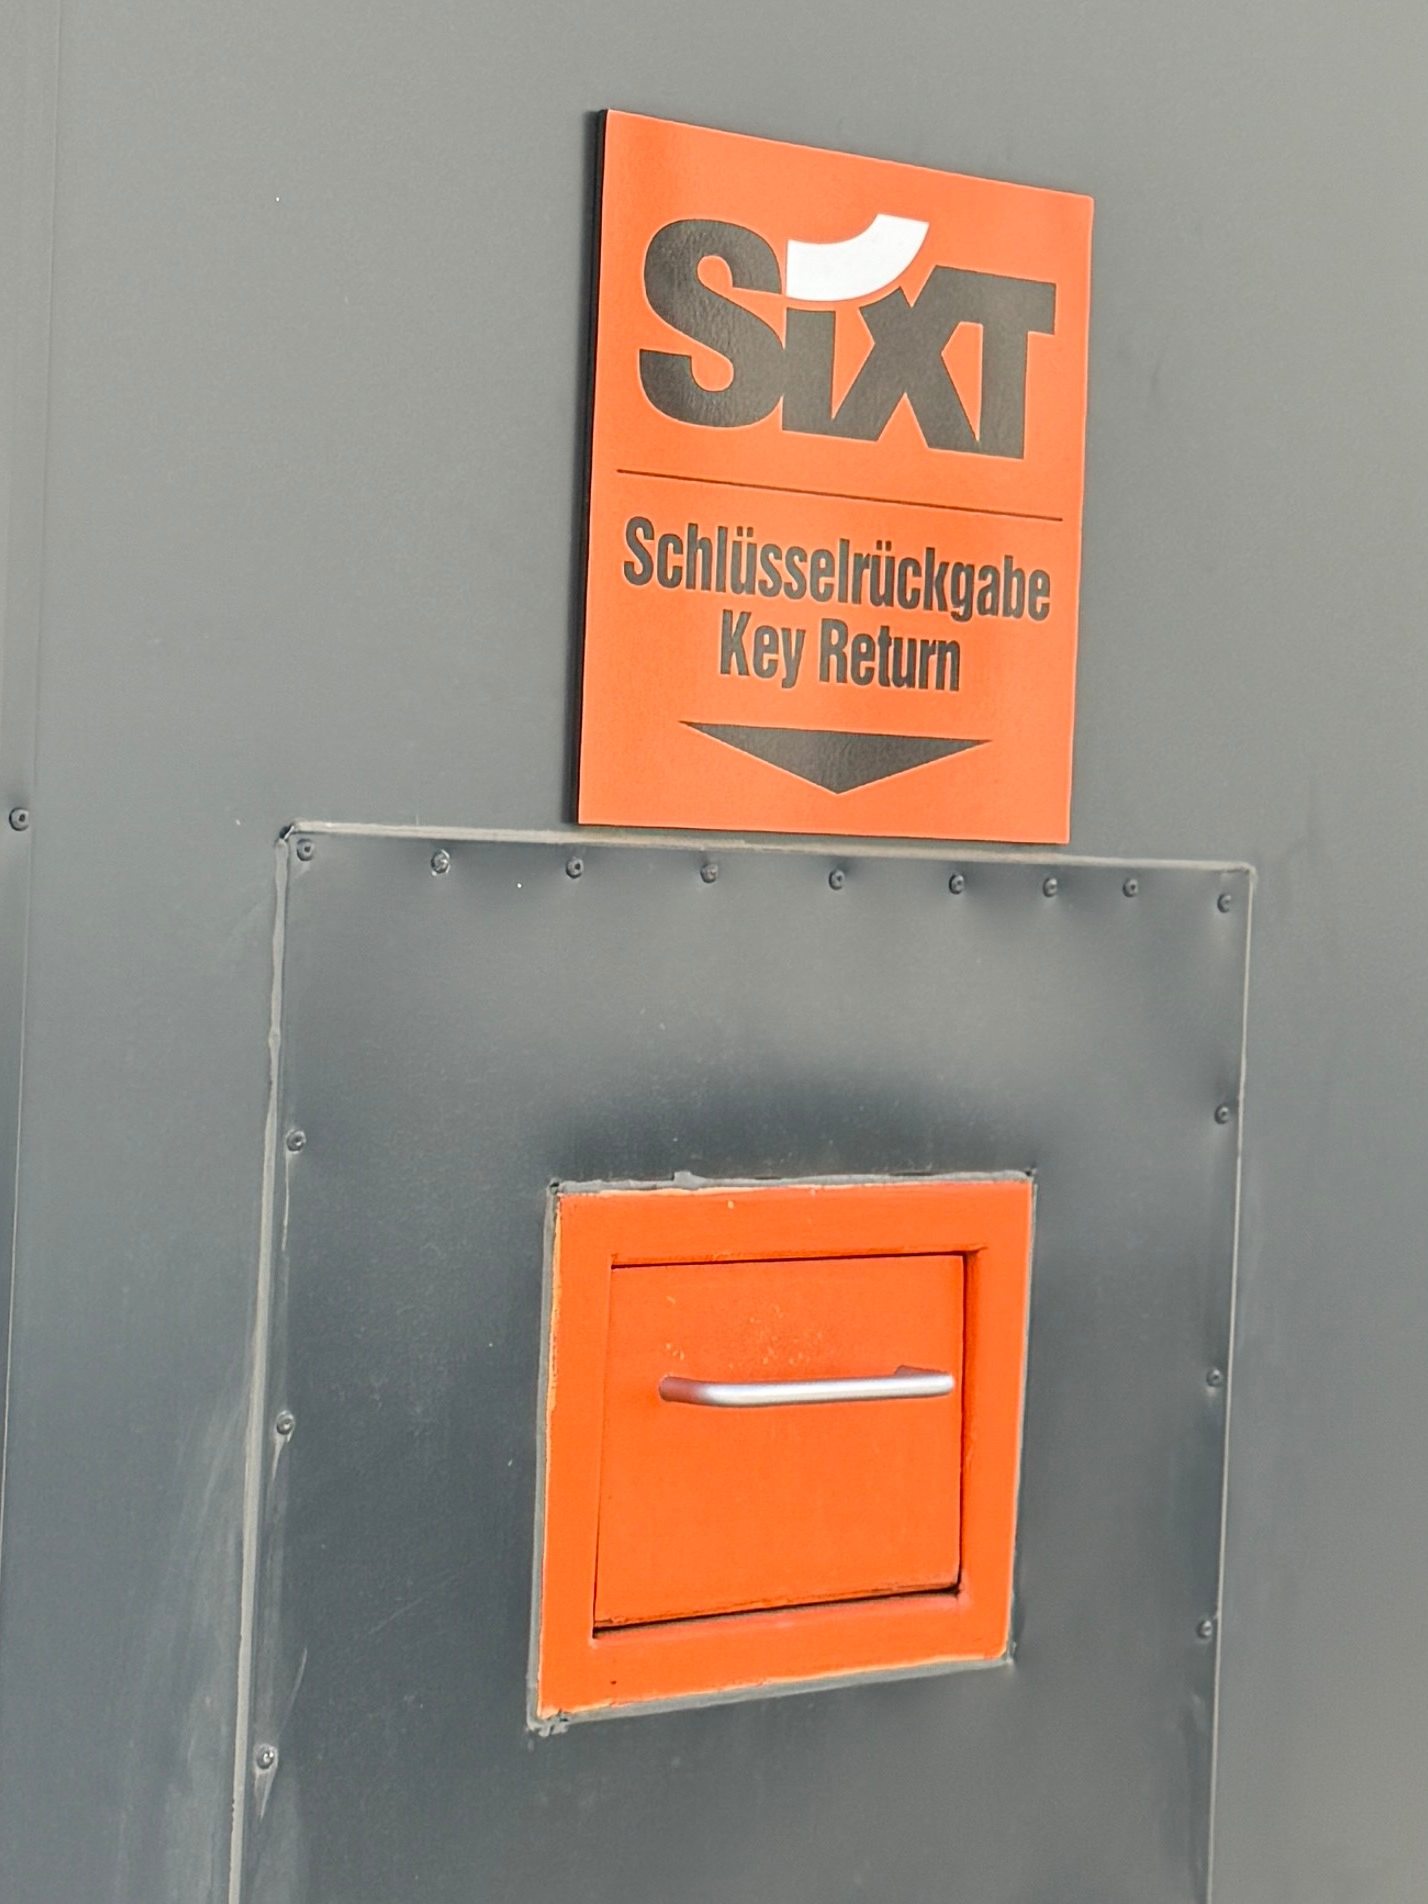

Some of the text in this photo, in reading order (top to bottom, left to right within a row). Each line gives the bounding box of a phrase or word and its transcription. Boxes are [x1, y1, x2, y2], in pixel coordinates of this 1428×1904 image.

[623, 516, 1051, 622] Schlüsselrückgabe
[719, 609, 961, 692] Key Return
